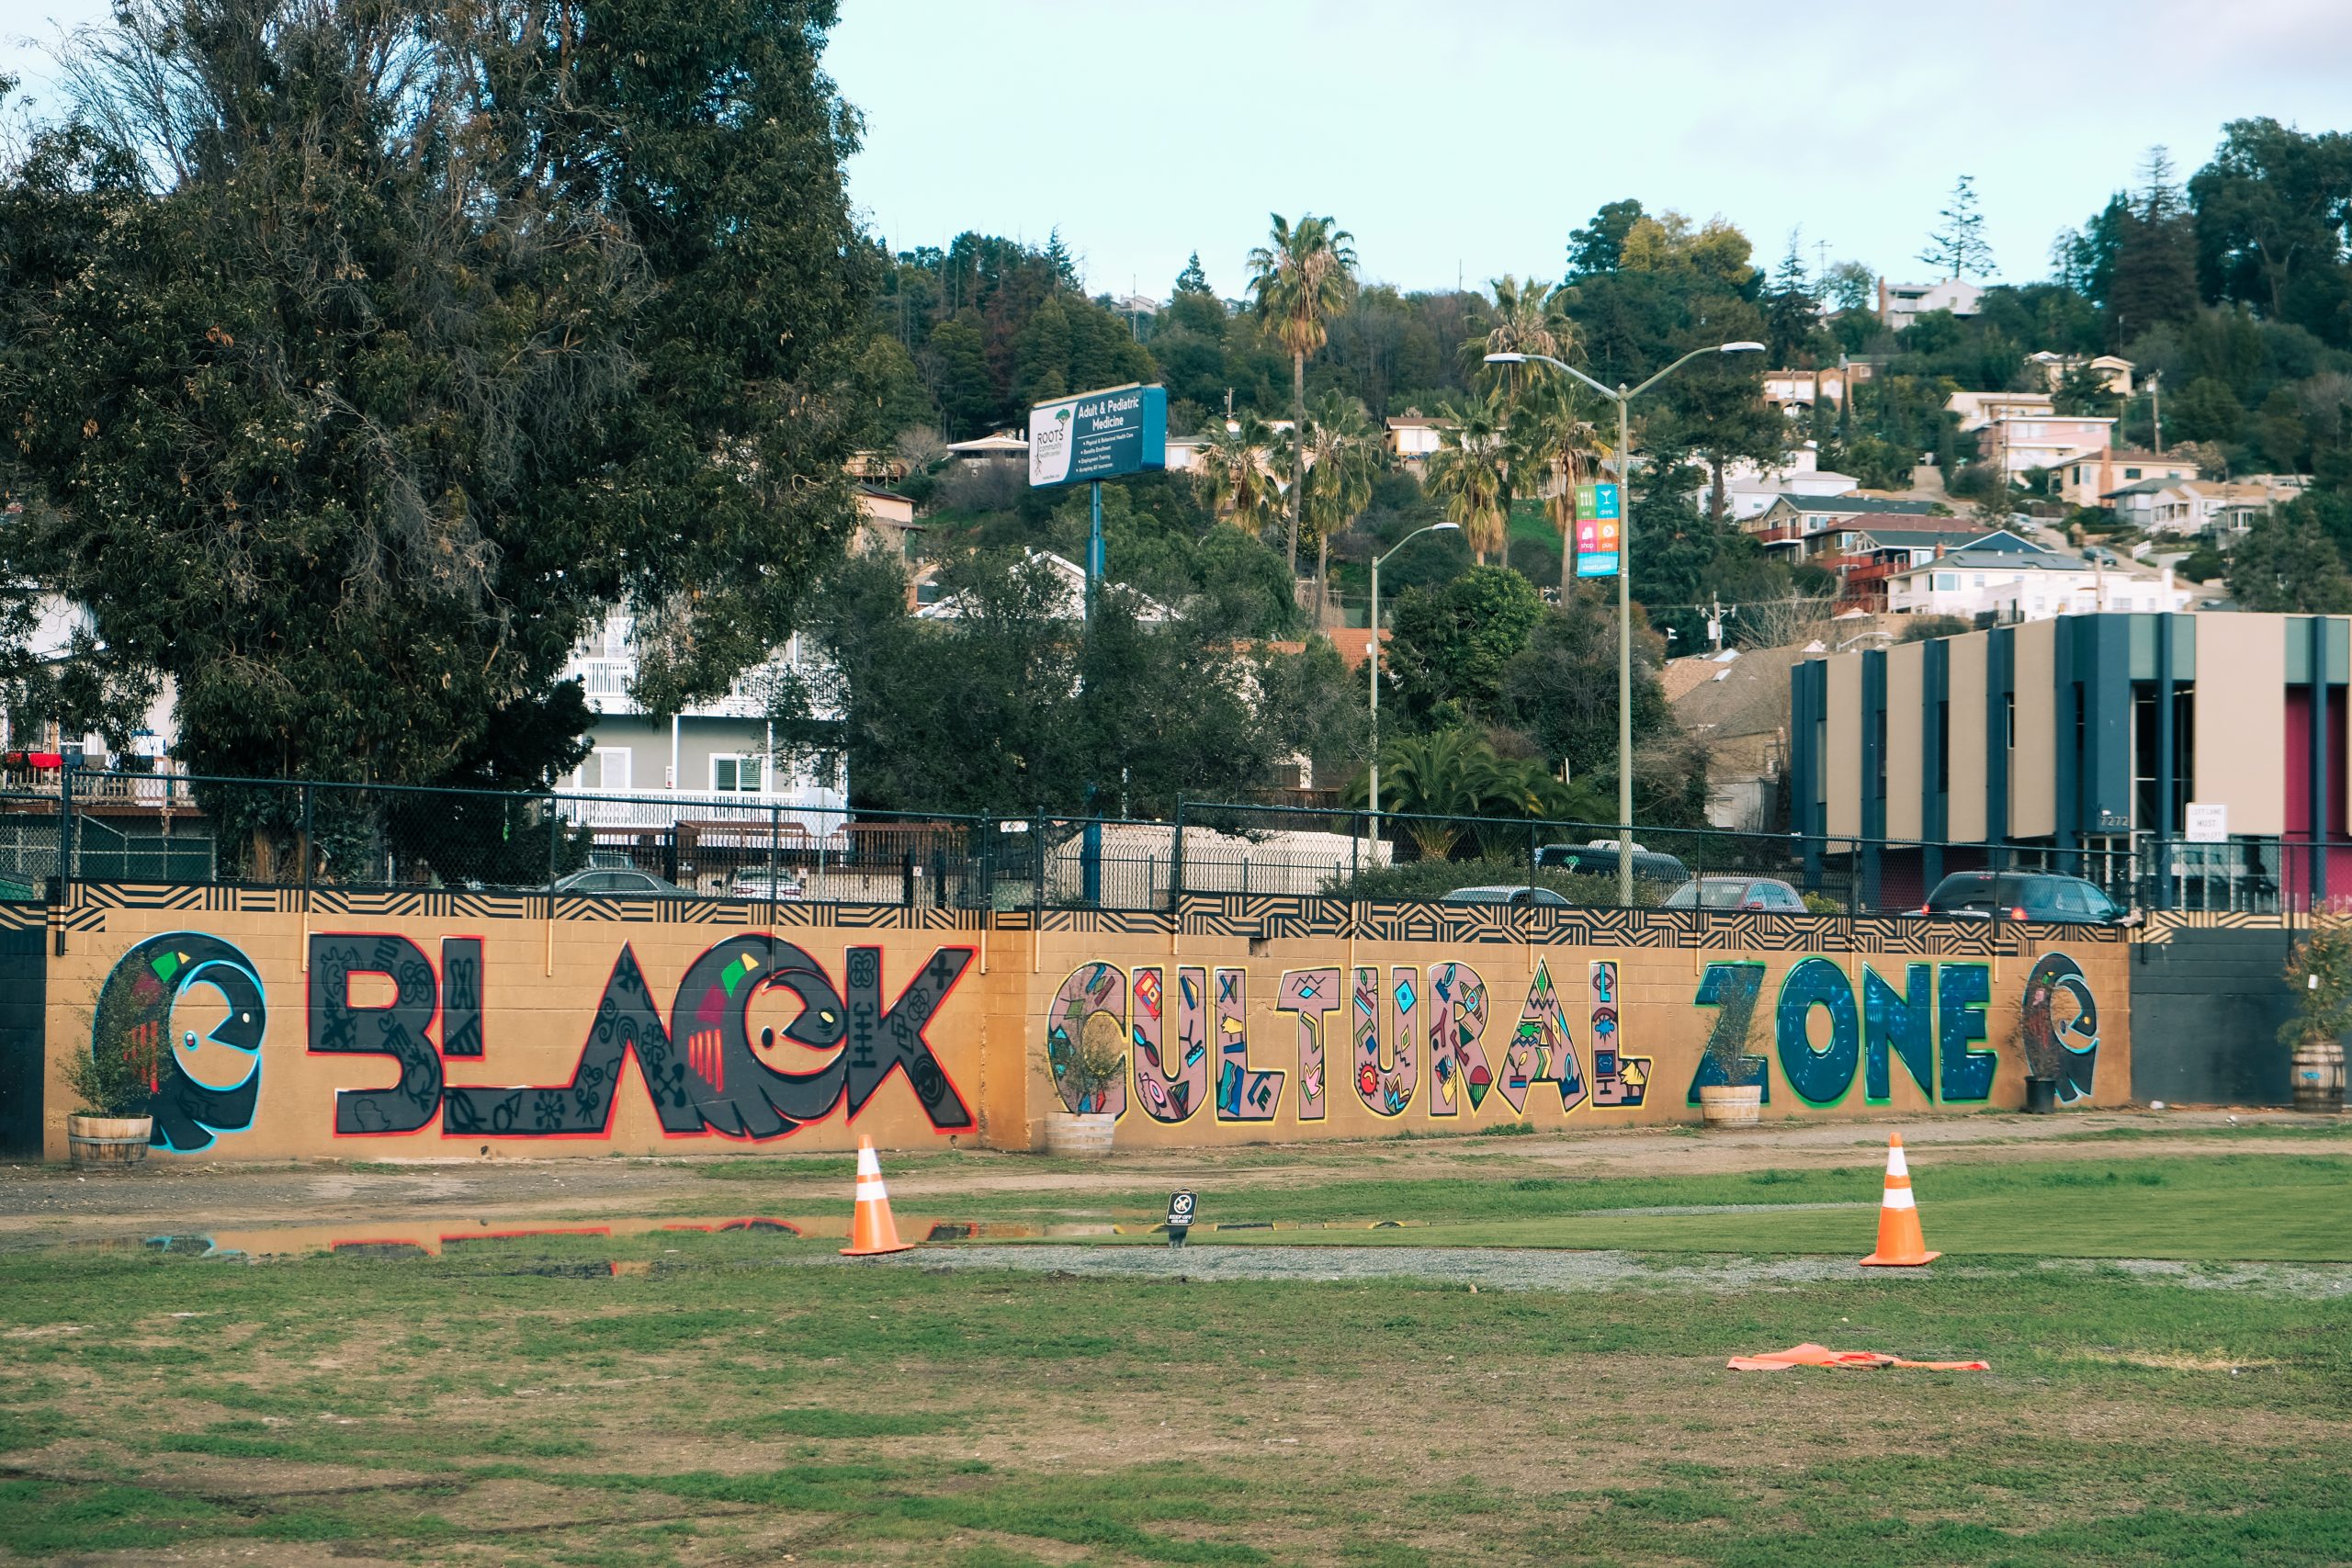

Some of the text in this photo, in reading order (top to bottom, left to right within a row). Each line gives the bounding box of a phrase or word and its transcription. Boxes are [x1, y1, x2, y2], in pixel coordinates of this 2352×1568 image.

[1079, 397, 1139, 419] Adult & Pediatric
[1092, 415, 1124, 431] Medicine
[1037, 430, 1063, 444] ROOTS
[2100, 816, 2130, 827] 7272
[2197, 819, 2217, 828] MUST
[306, 930, 980, 1143] BLACK
[1046, 953, 1655, 1127] CULTURAL
[1685, 954, 1999, 1109] ZONE
